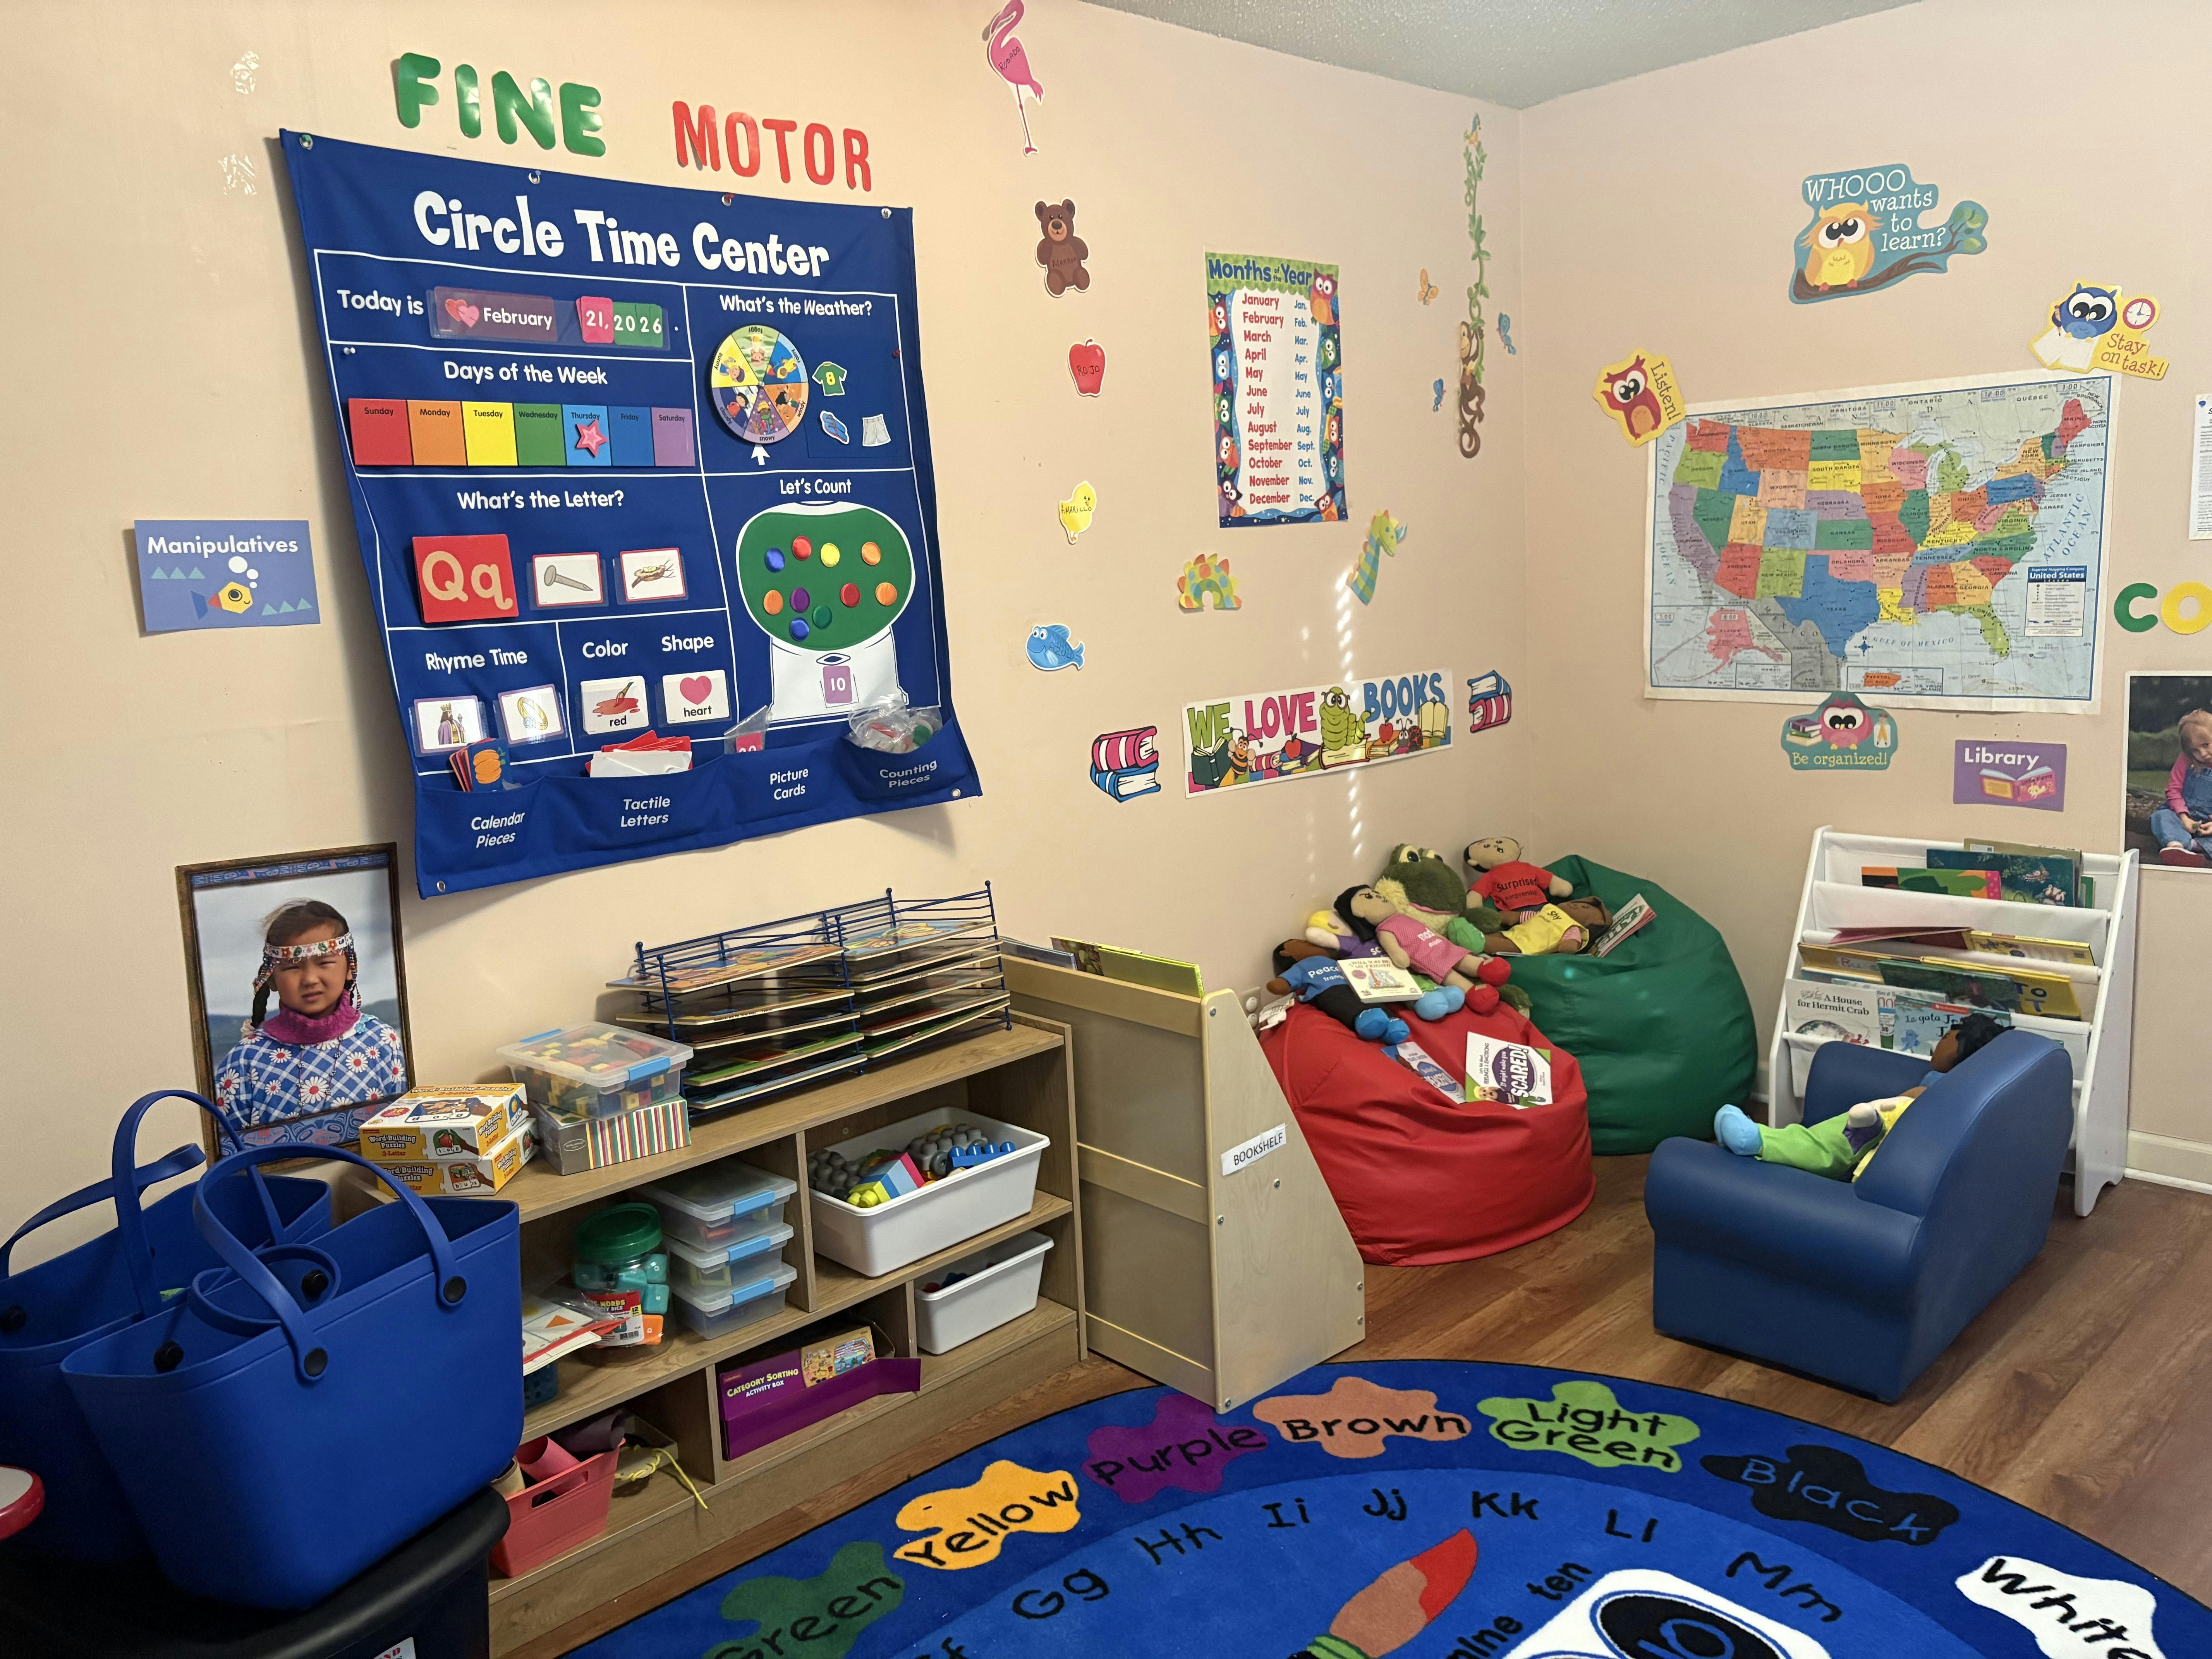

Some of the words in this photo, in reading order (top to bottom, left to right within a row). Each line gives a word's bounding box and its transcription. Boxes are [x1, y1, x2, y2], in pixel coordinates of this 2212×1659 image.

[397, 52, 606, 158] FINE
[672, 100, 872, 192] MOTOR
[1805, 169, 1906, 202] WHOOO
[1870, 188, 1933, 213] wants
[1890, 213, 1912, 233] to
[413, 191, 565, 257] Circle
[575, 208, 680, 266] Time
[692, 222, 830, 277] Center
[1880, 227, 1946, 252] learn?
[1208, 259, 1272, 282] Months
[1281, 263, 1312, 286] Year
[720, 294, 774, 313] What's
[778, 297, 801, 314] the
[804, 300, 872, 316] Weather?
[1242, 293, 1279, 310] January
[1294, 300, 1307, 310] Jan.
[337, 289, 402, 317] Today
[407, 294, 424, 315] is
[483, 307, 553, 330] February
[614, 310, 662, 333] 2026
[1242, 312, 1284, 328] February
[1294, 318, 1307, 328] Feb.
[1243, 330, 1272, 343] March
[1294, 336, 1309, 345] Mar.
[2107, 333, 2147, 355] Stay
[714, 352, 723, 370] sunny
[791, 349, 801, 363] rainy
[1245, 348, 1266, 362] April
[1295, 354, 1309, 365] Apr.
[2101, 351, 2121, 364] on
[2122, 355, 2165, 376] task!
[444, 361, 494, 383] Days
[499, 362, 518, 381] of
[521, 364, 553, 383] the
[557, 365, 608, 385] Week
[825, 371, 836, 385] 8
[1245, 367, 1263, 382] May
[1295, 371, 1308, 383] May
[1246, 385, 1267, 397] June
[1295, 389, 1311, 398] June
[1650, 361, 1681, 421] Listen!
[364, 407, 394, 417] Sunday
[419, 408, 451, 418] Monday
[473, 409, 503, 419] Tuesday
[519, 410, 558, 420] Wednesday
[571, 412, 600, 421] Thursday
[720, 407, 732, 424] cloudy
[797, 400, 806, 417] windy
[1247, 403, 1265, 418] July
[1296, 406, 1310, 418] July
[621, 413, 639, 422] Friday
[658, 414, 685, 423] Saturday
[1247, 421, 1277, 436] August
[1297, 424, 1312, 436] Aug.
[1248, 439, 1293, 454] September
[1297, 441, 1316, 453] Sept.
[1249, 457, 1283, 469] October
[1298, 458, 1313, 468] Oct.
[780, 478, 811, 495] Let's
[814, 478, 852, 494] Count
[1249, 475, 1290, 487] November
[1298, 476, 1313, 485] Nov.
[457, 490, 524, 510] What's
[529, 490, 560, 508] the
[564, 489, 624, 508] Letter?
[1249, 492, 1291, 505] December
[1299, 493, 1315, 502] Dec.
[148, 535, 298, 558] Manipulatives
[422, 550, 513, 610] Qq
[582, 641, 628, 659] Color
[661, 634, 714, 654] Shape
[425, 653, 486, 675] Rhyme
[489, 649, 528, 666] Time
[831, 677, 846, 692] 10
[683, 705, 712, 718] heart
[1187, 703, 1232, 749] WE
[1244, 691, 1317, 741] LOVE
[1363, 673, 1445, 723] BOOKS
[610, 715, 627, 728] red
[1792, 752, 1809, 765] Be
[1813, 752, 1888, 768] organized!
[1964, 747, 2040, 770] Library
[770, 768, 809, 785] Picture
[879, 760, 938, 778] Counting
[889, 774, 931, 788] Pieces
[773, 783, 806, 800] Cards
[623, 796, 670, 811] Tactile
[471, 812, 526, 831] Calendar
[621, 813, 669, 828] Letters
[476, 831, 516, 848] Pieces
[1547, 910, 1562, 921] Shy
[1797, 999, 1811, 1007] for
[1812, 1001, 1846, 1012] Hermit
[1846, 1006, 1870, 1015] Crab
[1832, 995, 1863, 1006] House
[1918, 1013, 1941, 1024] gata
[1507, 1044, 1530, 1098] SCARED!
[368, 1135, 387, 1144] Word
[387, 1135, 417, 1144] Building
[1233, 1132, 1283, 1166] BOOKSHELF
[400, 1167, 434, 1176] Building
[600, 1299, 626, 1308] WORDS
[726, 1376, 765, 1398] CATEGORY
[766, 1368, 799, 1382] SORTING
[745, 1382, 771, 1398] ACTIVITY
[772, 1379, 785, 1389] BOX
[1282, 1414, 1472, 1442] Brown
[1527, 1402, 1668, 1437] Light
[1495, 1419, 1674, 1469] Green
[1090, 1425, 1269, 1486] Purple
[1362, 1488, 1408, 1522] Jj
[1471, 1489, 1540, 1521] Kk
[1739, 1457, 1930, 1542] Black
[903, 1479, 1075, 1567] Yellow
[1133, 1522, 1223, 1565] Hh
[1526, 1561, 1593, 1601] ten
[1724, 1551, 1843, 1624] Mm
[1013, 1568, 1110, 1619] Gg
